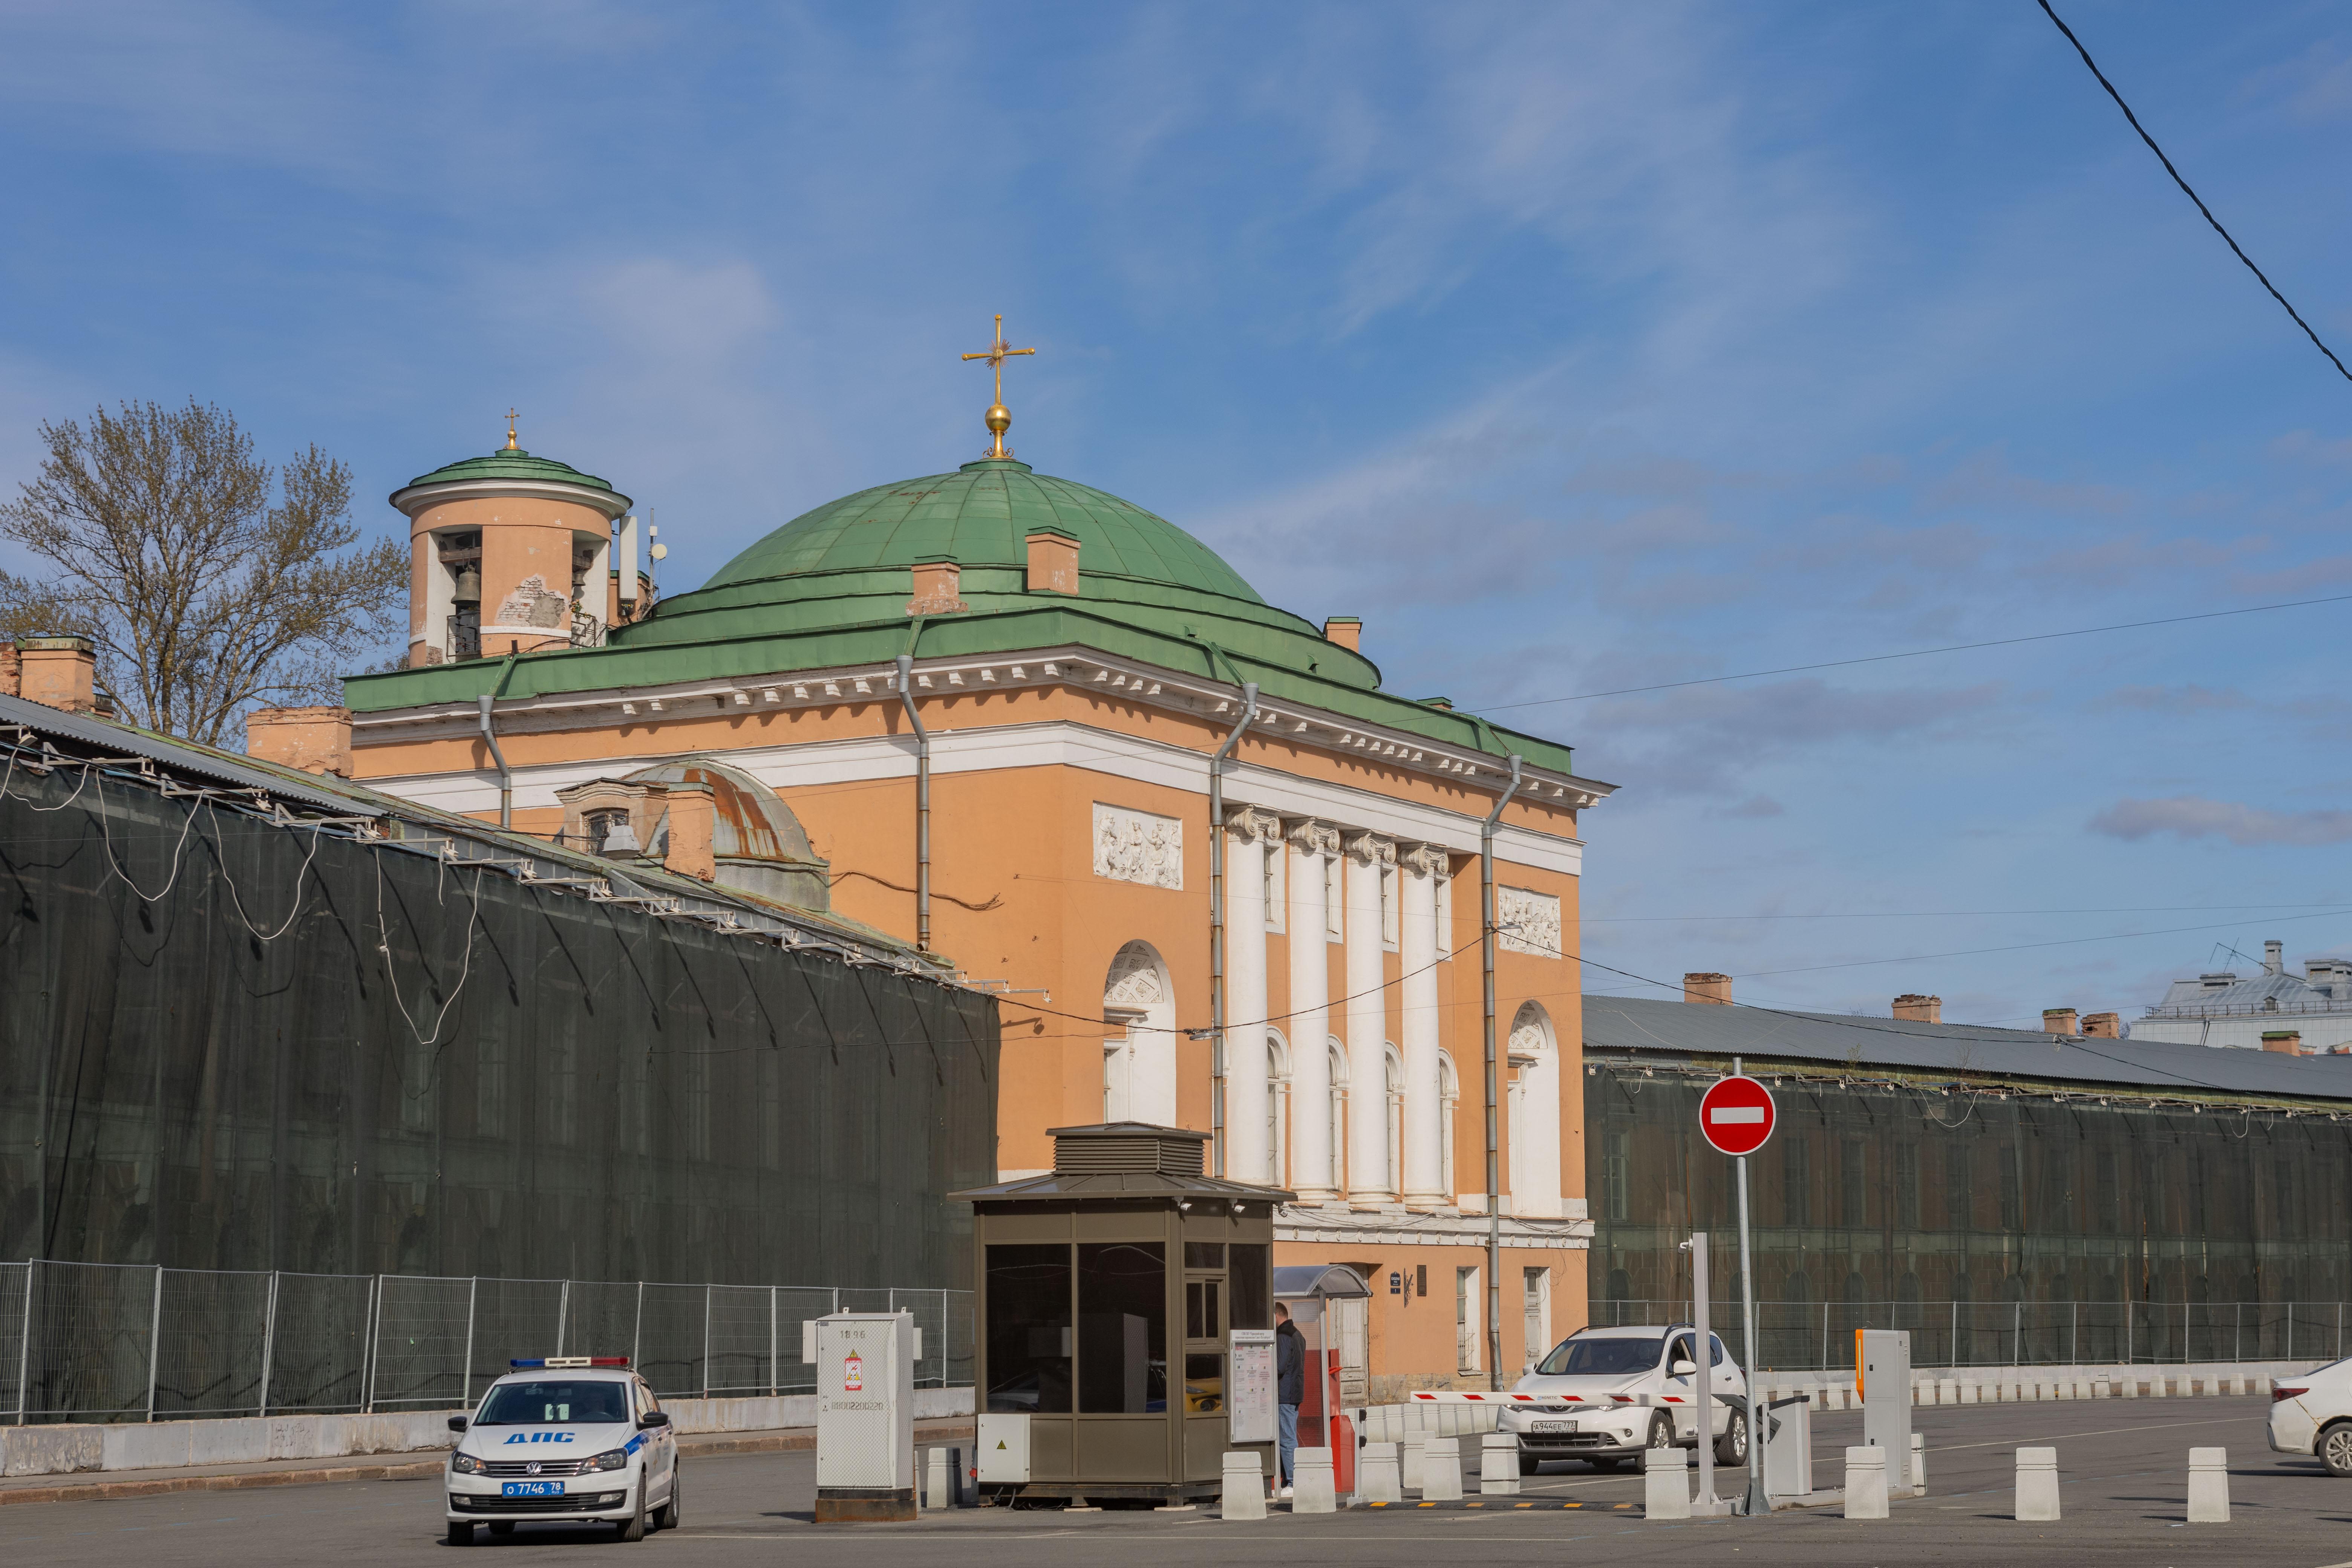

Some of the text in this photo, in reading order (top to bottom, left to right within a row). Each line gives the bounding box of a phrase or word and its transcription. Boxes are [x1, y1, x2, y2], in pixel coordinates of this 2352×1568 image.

[841, 1330, 865, 1338] 1896
[831, 1402, 884, 1410] 88002200220
[503, 1432, 575, 1444] ДПС
[518, 1483, 545, 1494] 7746
